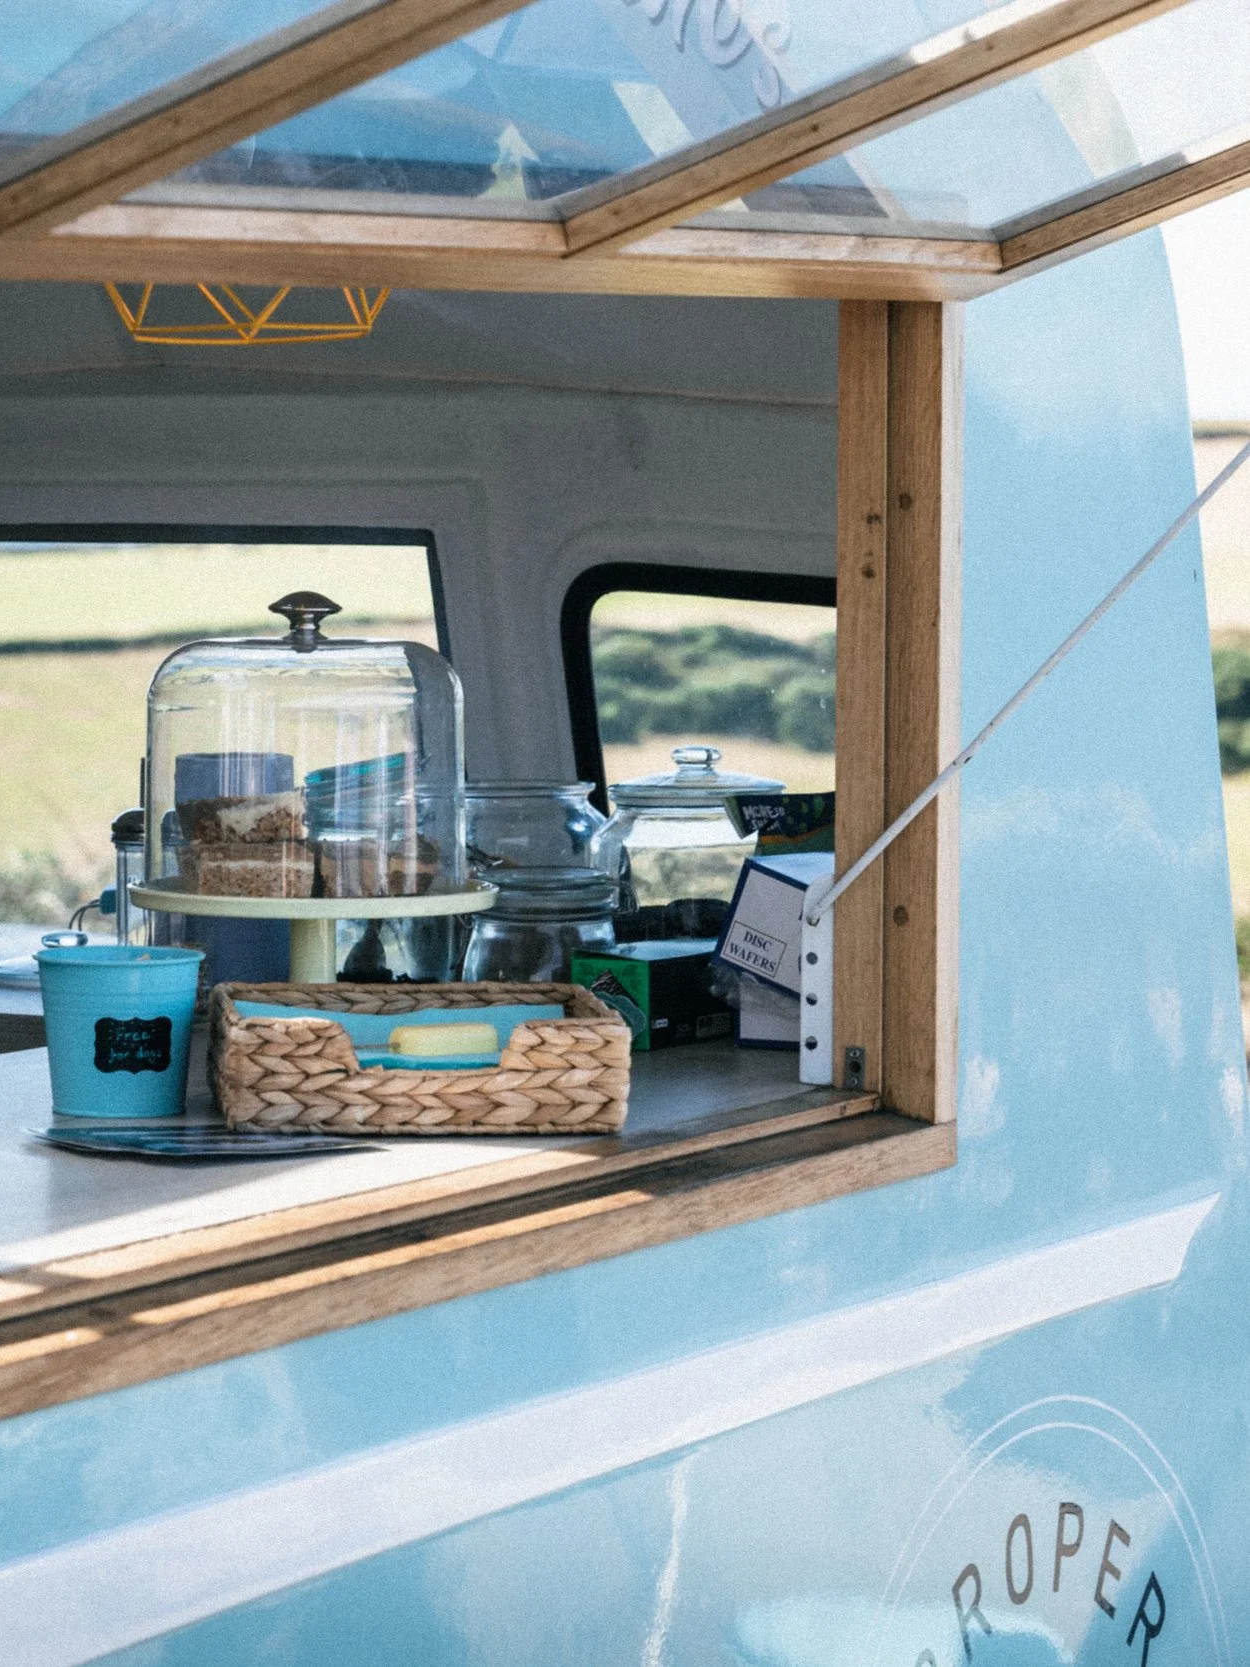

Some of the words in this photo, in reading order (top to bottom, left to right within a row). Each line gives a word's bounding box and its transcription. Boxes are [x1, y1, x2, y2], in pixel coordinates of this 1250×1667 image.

[743, 931, 772, 952] DISC
[729, 942, 777, 973] WAFERS
[914, 1501, 1166, 1667] ROPER
